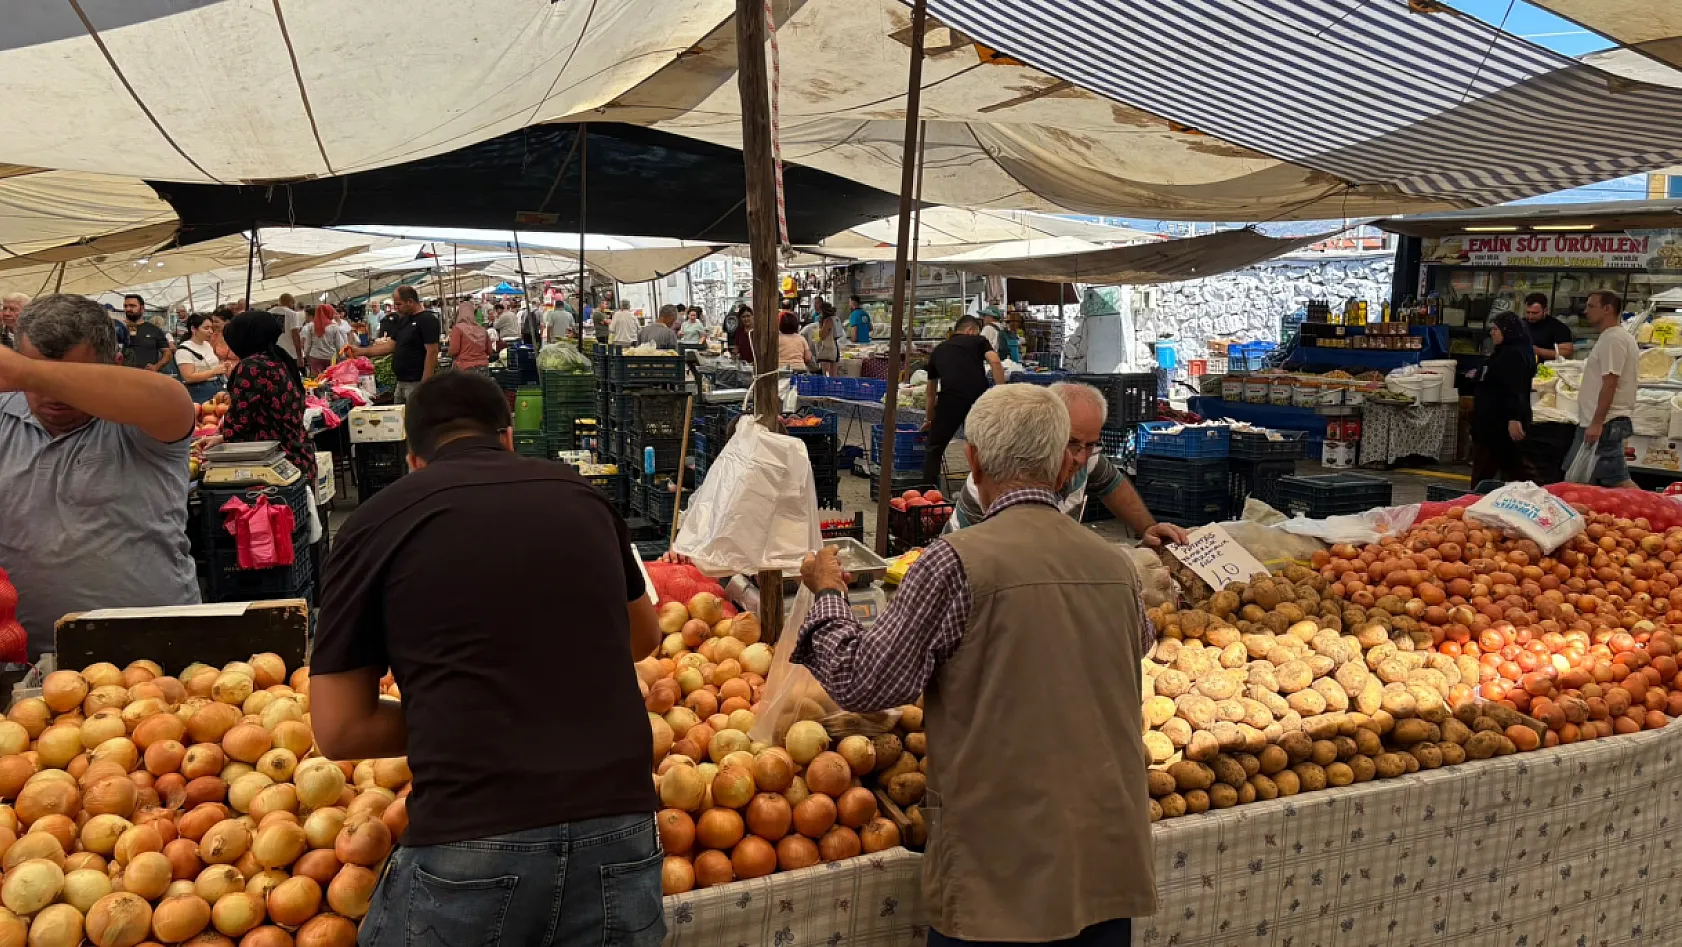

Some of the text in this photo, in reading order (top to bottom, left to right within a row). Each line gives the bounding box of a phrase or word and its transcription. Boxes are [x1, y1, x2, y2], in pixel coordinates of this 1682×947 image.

[1468, 233, 1649, 254] EMİN SÜT ÜRÜNLERİ
